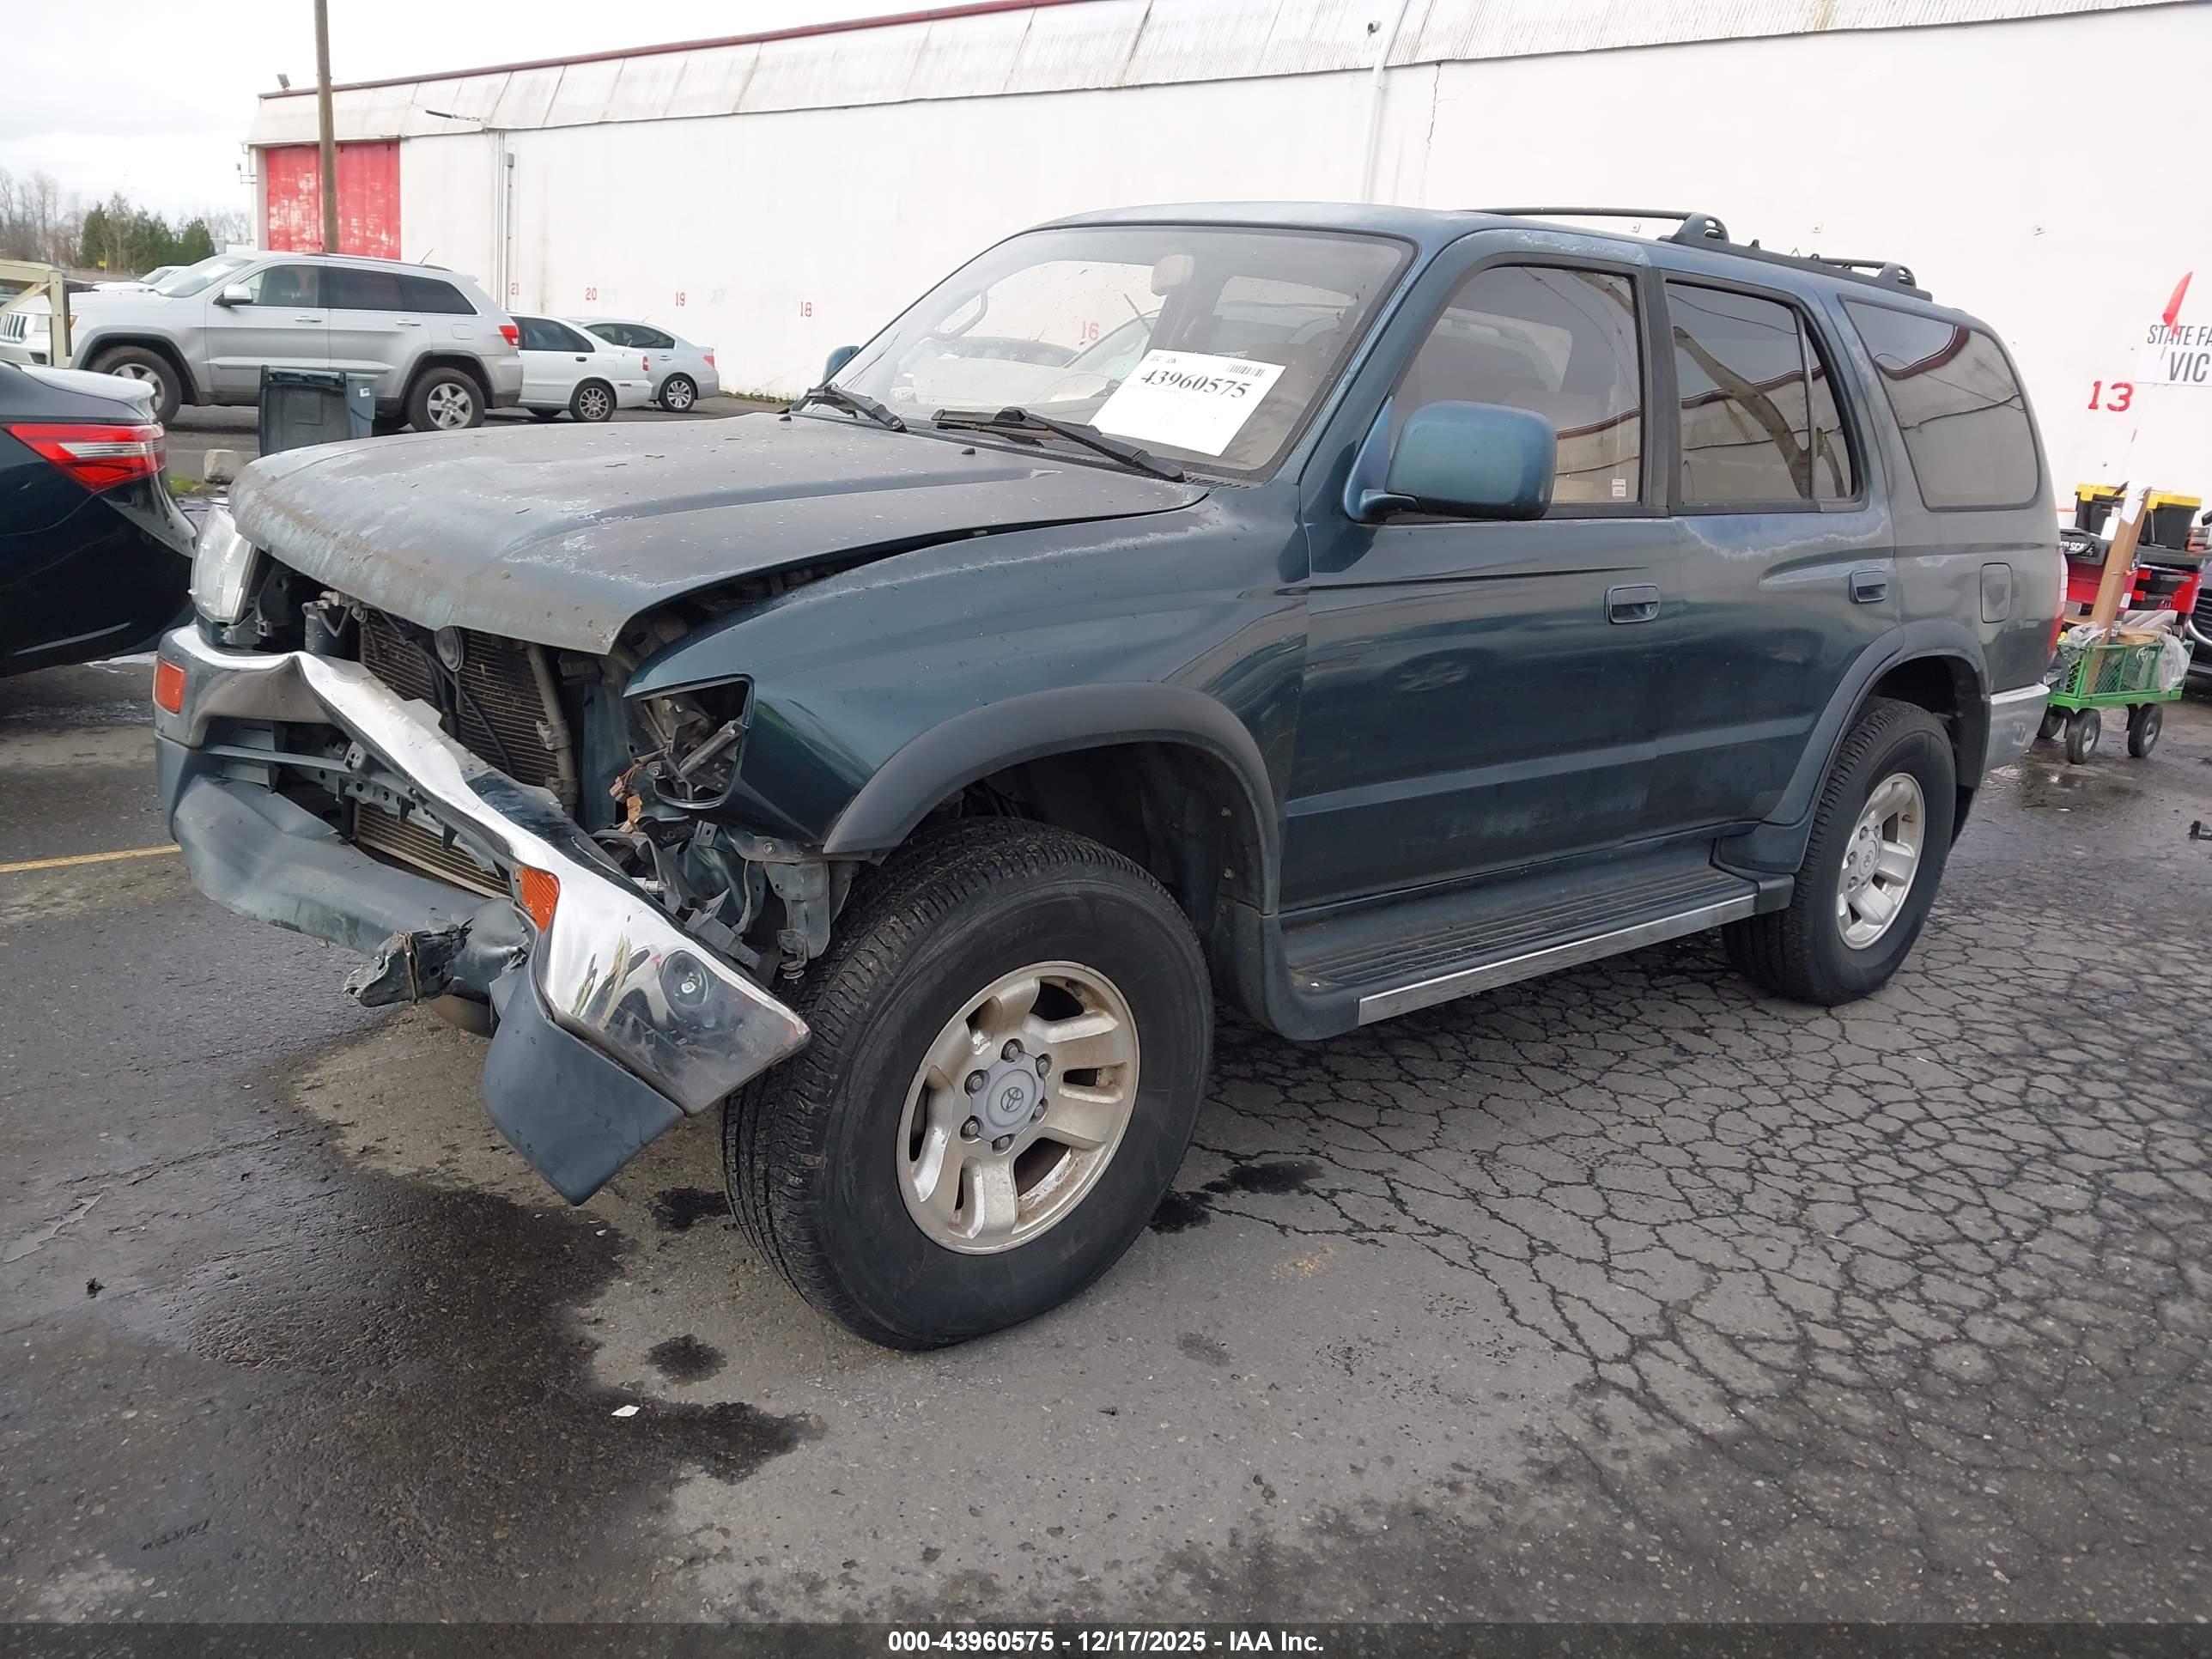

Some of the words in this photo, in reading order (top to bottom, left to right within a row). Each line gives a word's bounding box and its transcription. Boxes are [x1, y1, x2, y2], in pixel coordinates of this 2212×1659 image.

[586, 288, 597, 301] 20
[676, 292, 685, 307] 19
[800, 301, 812, 317] 18
[1081, 320, 1099, 341] 16
[2147, 325, 2194, 345] STATE
[2169, 352, 2210, 382] VIC
[1141, 369, 1252, 398] 43960575
[2088, 380, 2134, 411] 13
